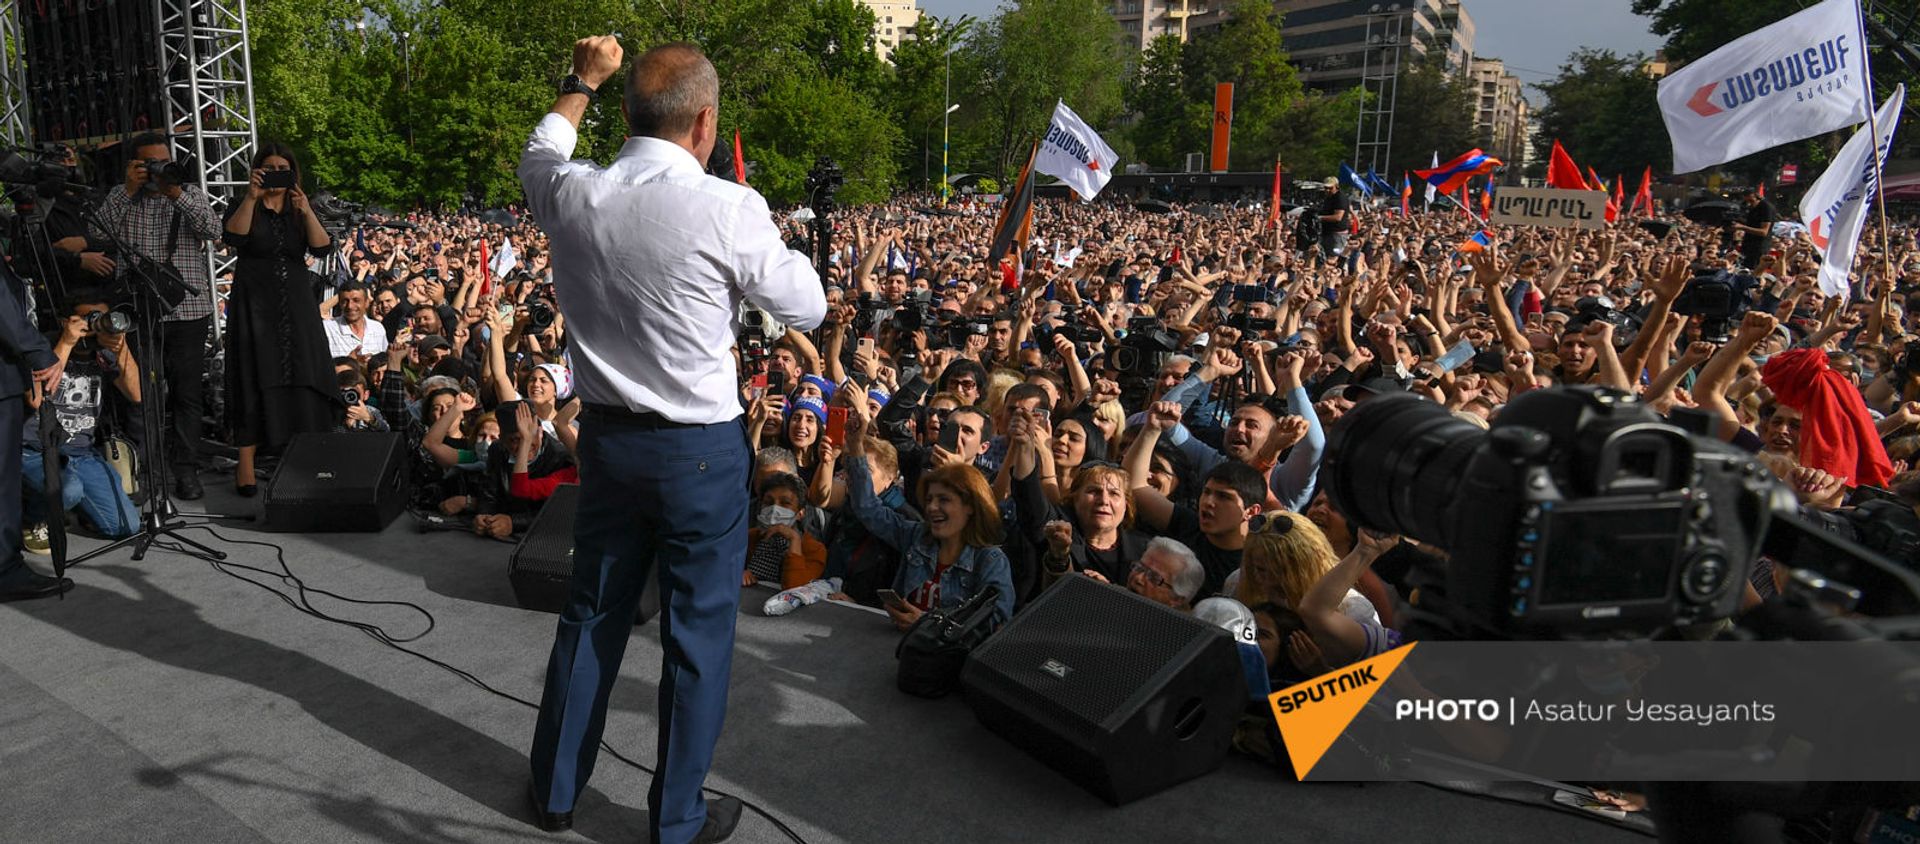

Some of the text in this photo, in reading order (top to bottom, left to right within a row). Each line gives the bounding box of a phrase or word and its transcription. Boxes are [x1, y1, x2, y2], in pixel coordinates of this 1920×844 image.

[1215, 111, 1228, 123] R
[1149, 176, 1218, 184] RICH
[1498, 196, 1593, 220] ԱՊԱՐԱՆ
